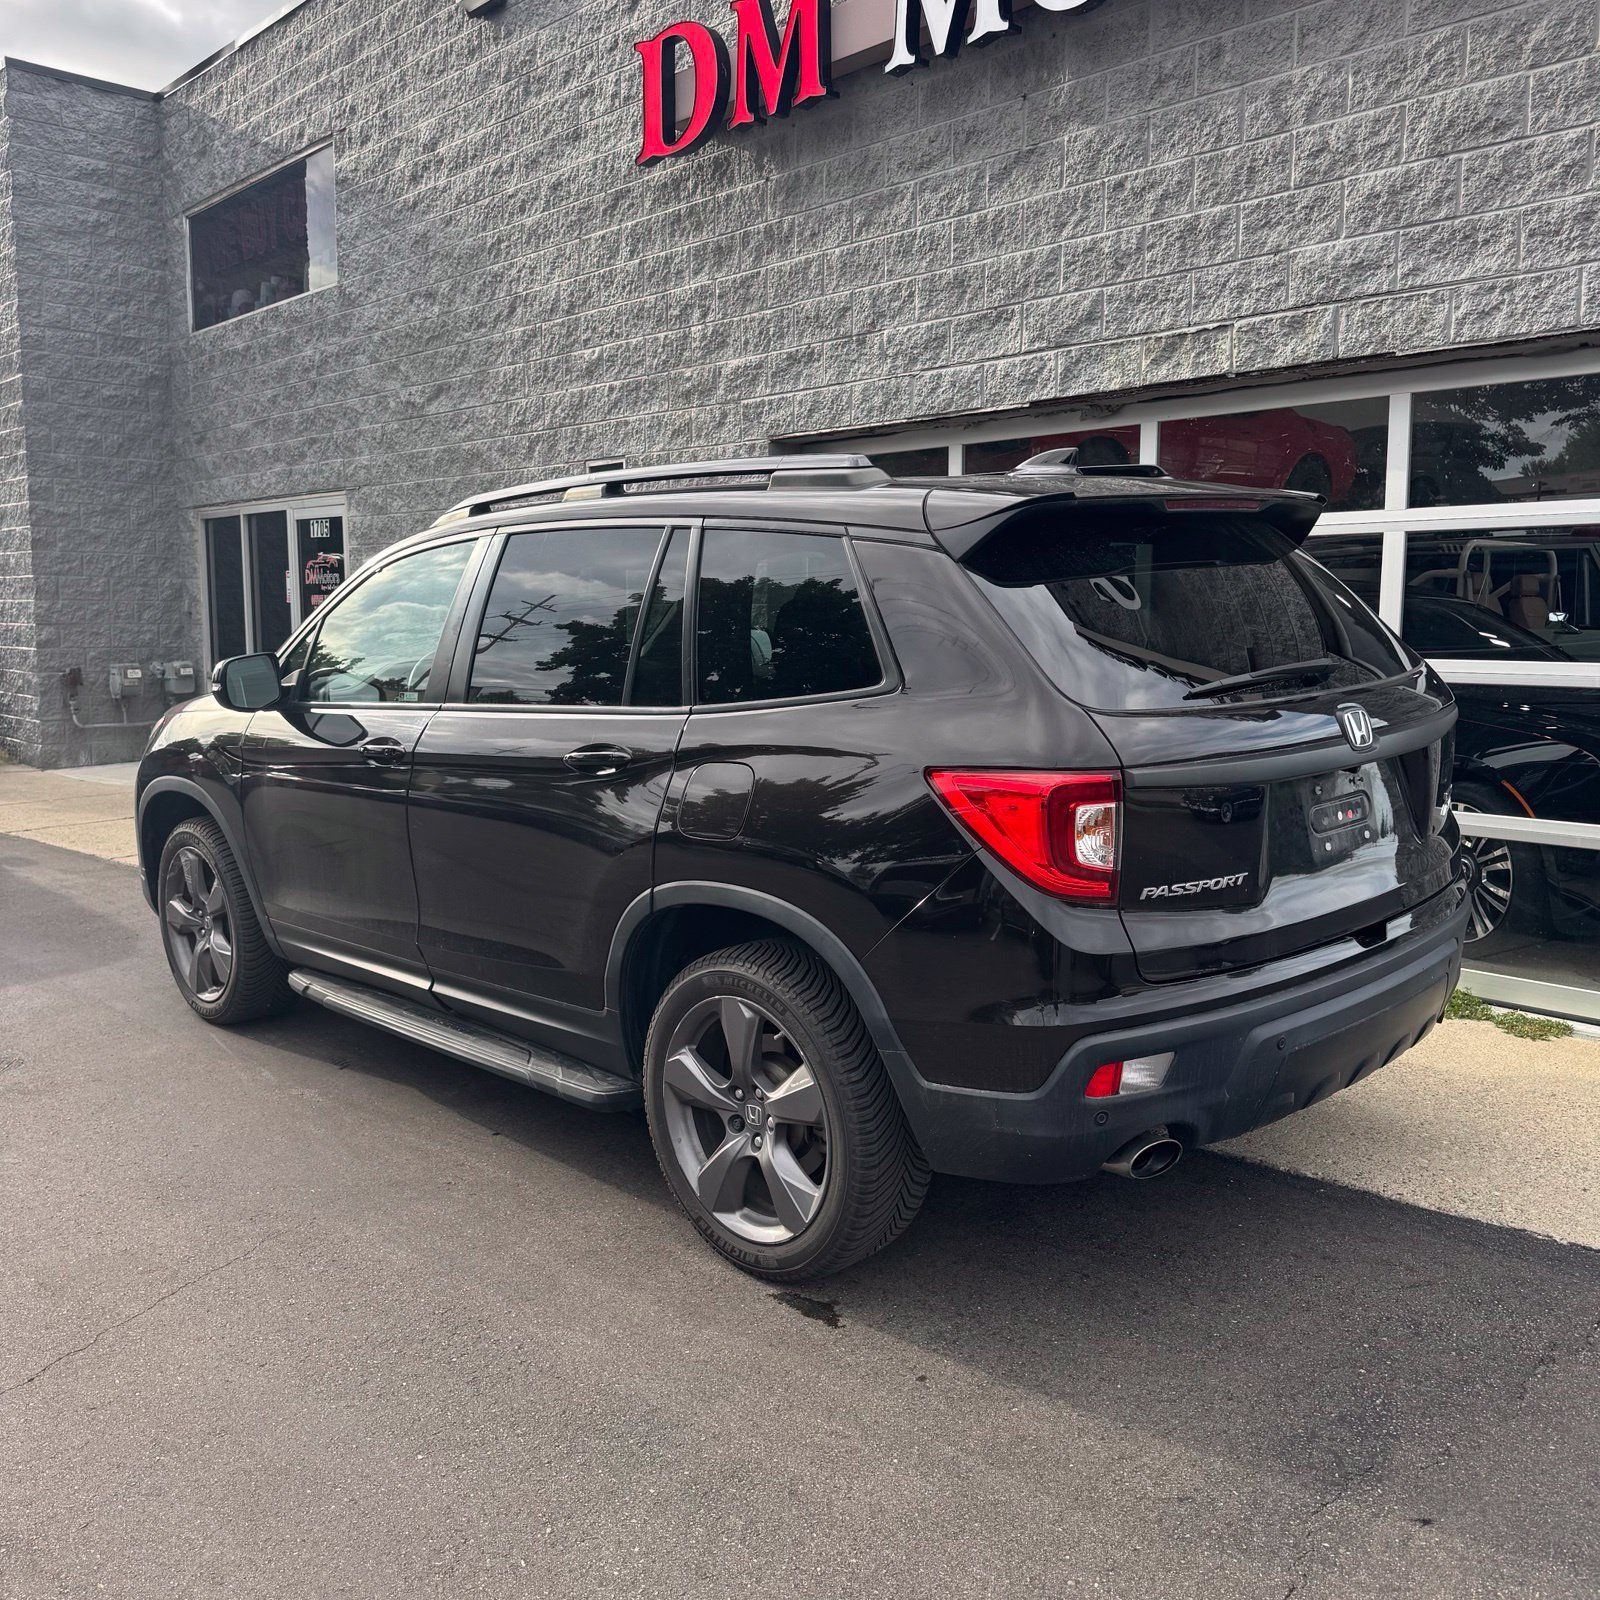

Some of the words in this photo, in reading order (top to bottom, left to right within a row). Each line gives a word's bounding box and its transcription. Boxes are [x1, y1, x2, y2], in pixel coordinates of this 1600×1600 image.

[635, 0, 827, 165] DM
[310, 519, 330, 538] 1705
[1139, 872, 1249, 900] PASSPORT
[723, 975, 787, 1017] MICHELIN
